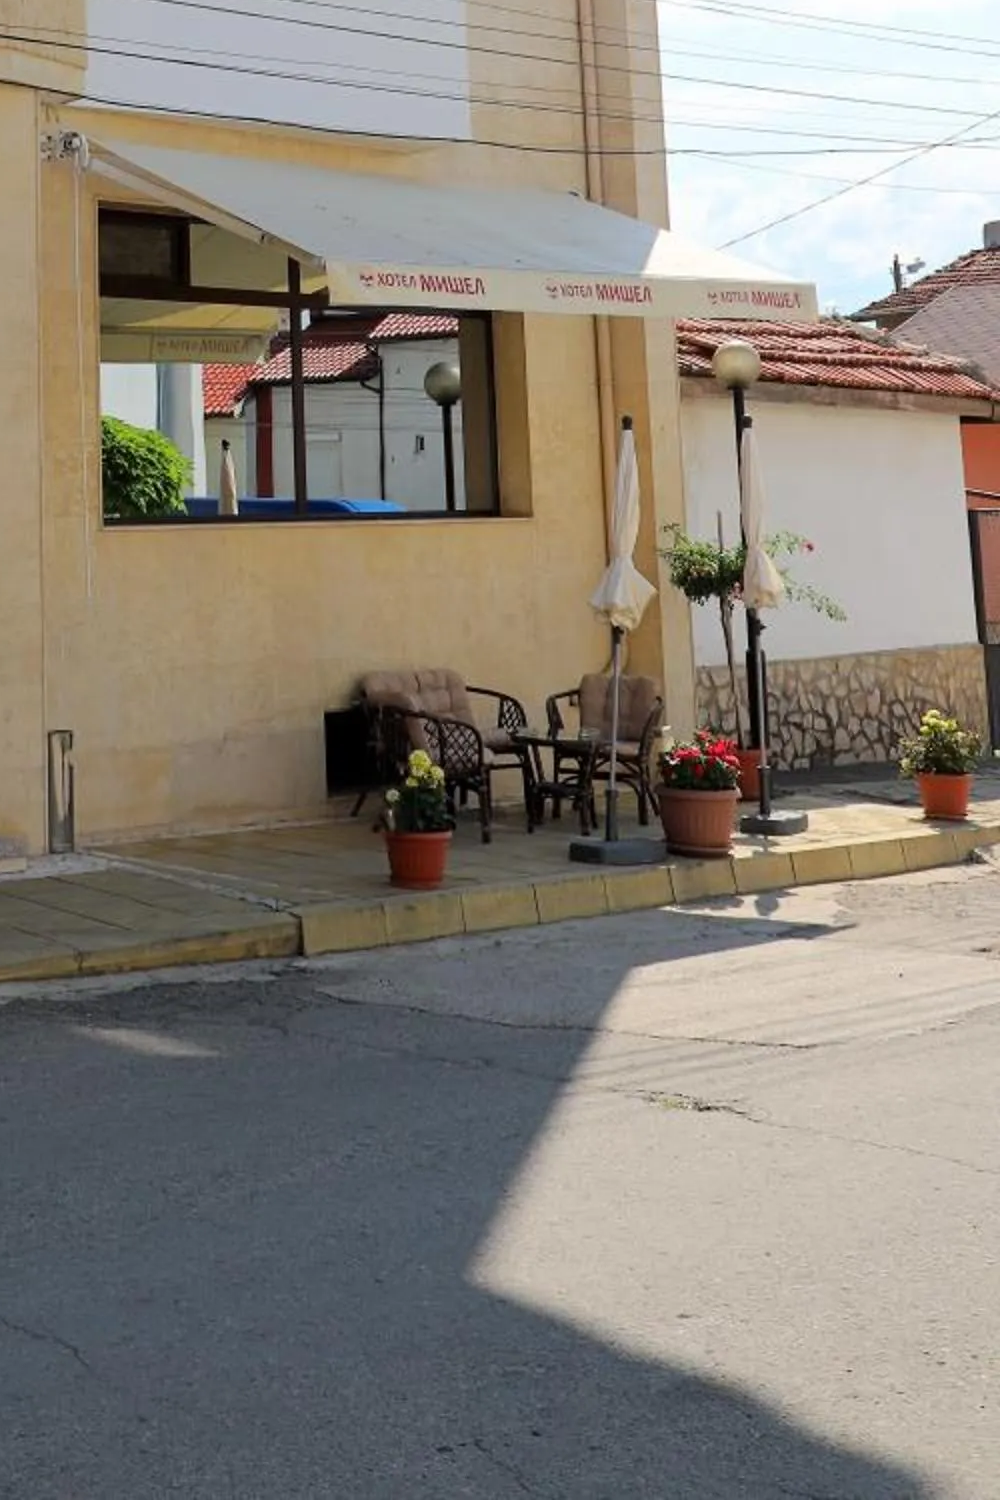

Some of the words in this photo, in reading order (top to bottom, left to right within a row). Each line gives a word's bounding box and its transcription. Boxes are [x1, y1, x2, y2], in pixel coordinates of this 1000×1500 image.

[377, 272, 416, 289] ХОТЕЛ
[419, 274, 486, 296] МИШЕЛ
[595, 283, 653, 304] МИШЕЛ
